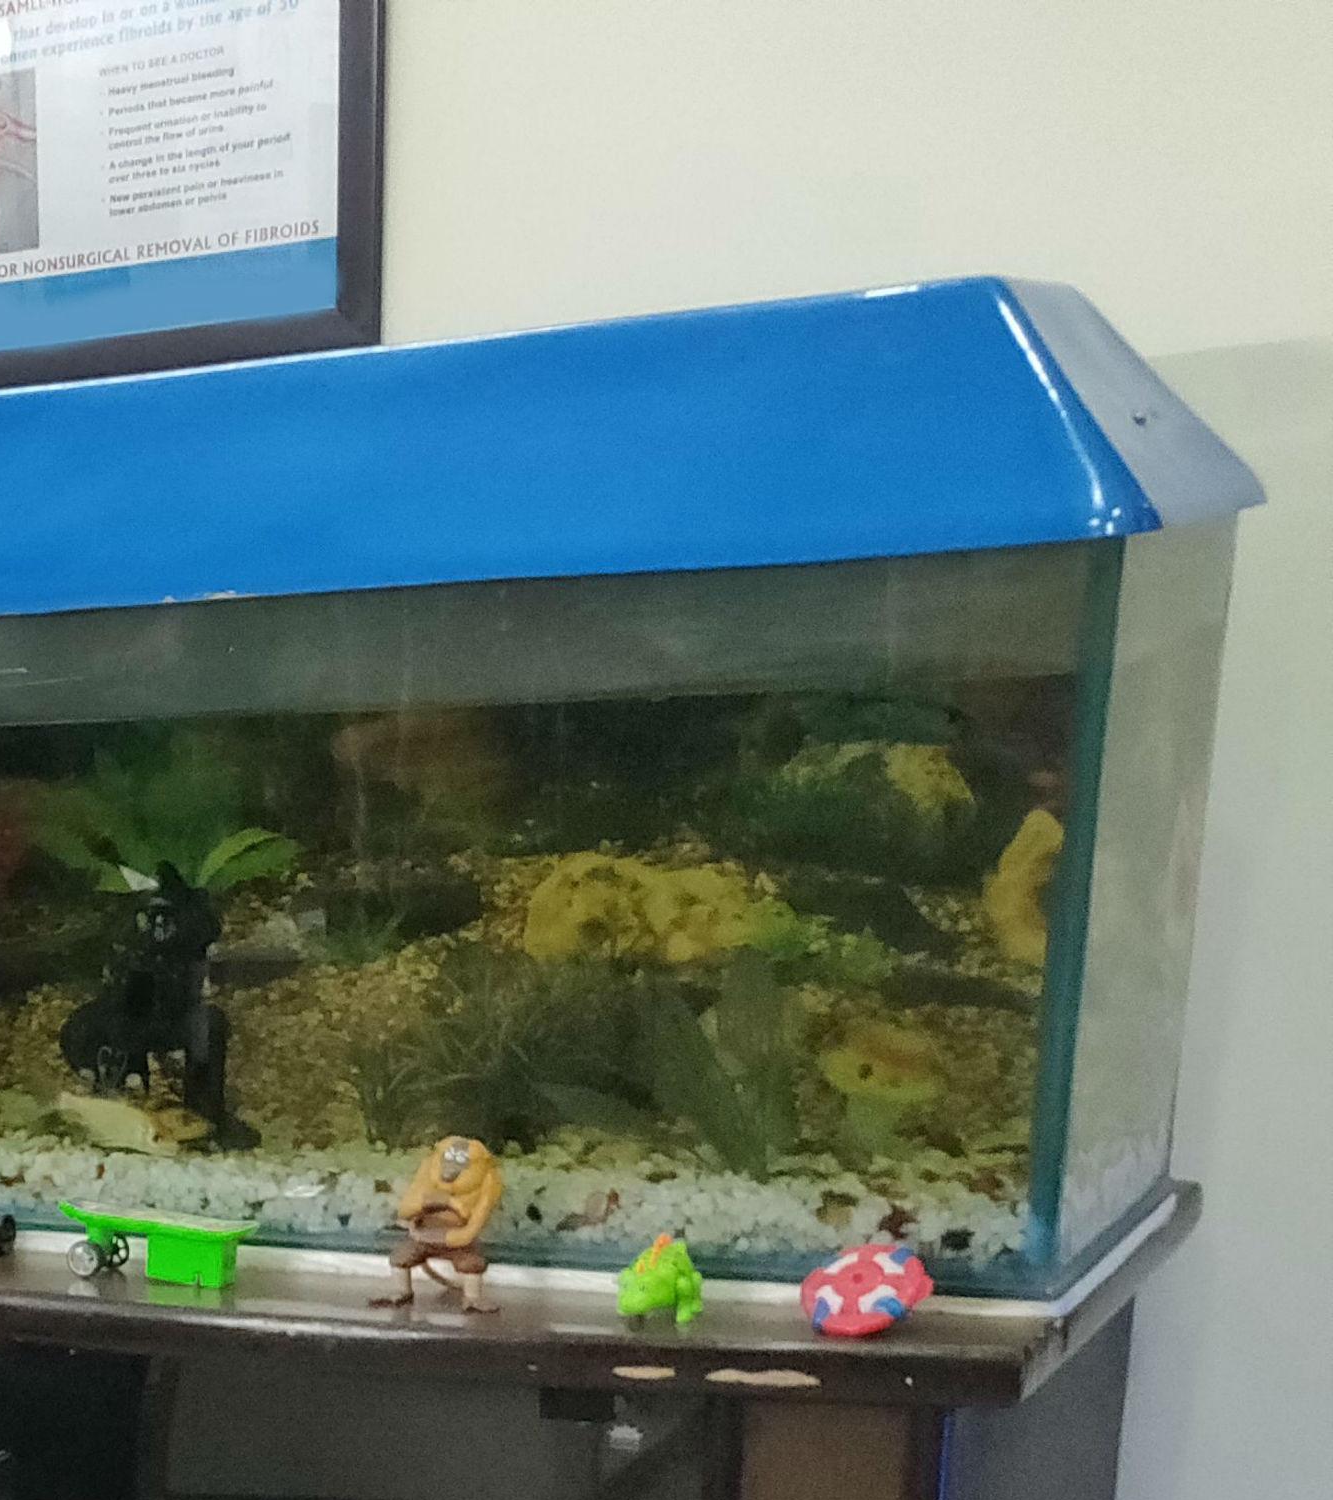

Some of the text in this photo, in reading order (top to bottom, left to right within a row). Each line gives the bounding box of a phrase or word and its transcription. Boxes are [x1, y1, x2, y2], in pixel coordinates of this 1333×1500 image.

[41, 32, 115, 58] experience
[118, 20, 173, 43] fibroids
[177, 15, 193, 32] by
[199, 10, 223, 27] the
[227, 7, 251, 24] age
[23, 248, 132, 276] NONSURGICAL
[137, 237, 212, 261] REMOVAL
[217, 232, 239, 248] OF
[244, 220, 321, 245] FIBROIDS
